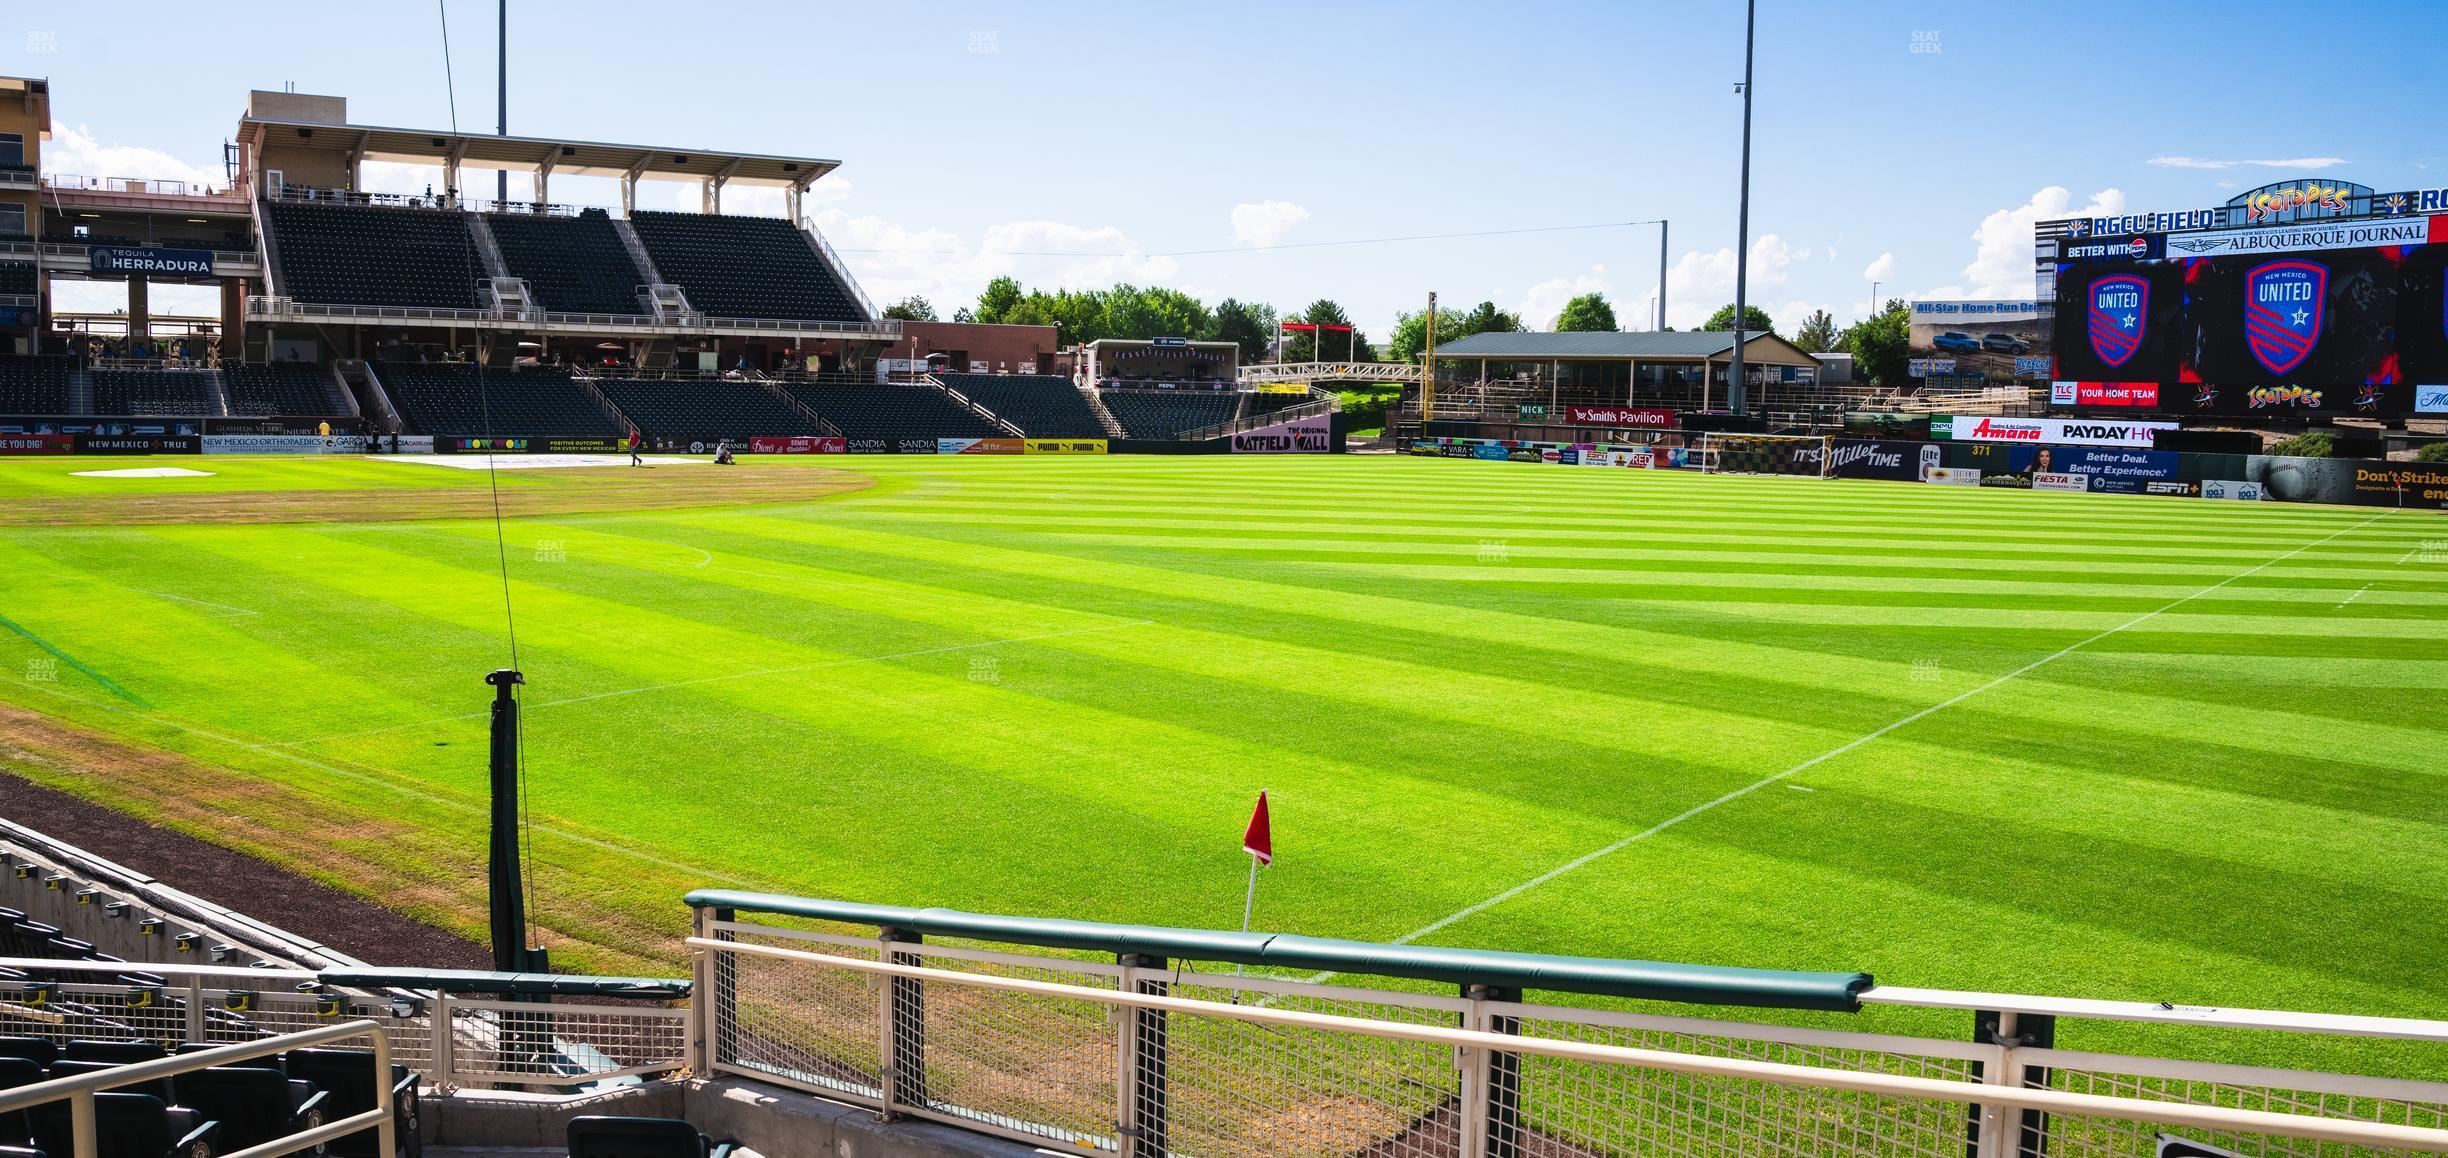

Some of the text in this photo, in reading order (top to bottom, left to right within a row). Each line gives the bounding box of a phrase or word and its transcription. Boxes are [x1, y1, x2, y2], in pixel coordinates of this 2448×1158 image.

[2245, 182, 2350, 222] ISOTOPES
[2093, 209, 2215, 236] RGCU FIELD
[2229, 225, 2426, 250] ALBUQUERQUE JOURNAL
[112, 249, 154, 257] TEQUILA
[2068, 244, 2132, 258] BETTER WITH
[112, 258, 210, 272] HERRADURA
[2259, 282, 2312, 302] UNITED
[2099, 293, 2138, 308] UNITED
[1916, 303, 1959, 313] All-Star
[1962, 303, 1994, 313] Home
[1996, 303, 2019, 313] Run
[2296, 313, 2304, 321] 18
[2055, 386, 2073, 394] TLC
[2081, 389, 2155, 398] YOUR HOME TEAM
[2247, 384, 2323, 409] ISOTOPES
[1521, 406, 1544, 414] NICK
[1587, 409, 1664, 424] Smith's Pavilion
[1972, 419, 2042, 439] Amana
[2063, 425, 2130, 439] PAYDAY
[9, 440, 25, 448] YOU
[27, 440, 43, 448] DIG!
[202, 438, 322, 446] NEW MEXICO ORTHOPAEDICS
[457, 439, 527, 448] MEOW WOLF
[752, 440, 775, 453] Dion's
[822, 440, 845, 453] Dion's
[848, 440, 887, 448] SANDIA
[898, 440, 937, 448] SANDIA
[1038, 443, 1060, 451] PUMA
[1072, 443, 1094, 451] PUMA
[1235, 435, 1328, 451] OATFIELD WALL
[1824, 444, 1880, 468] Miller
[1922, 450, 1939, 461] Lite
[1972, 446, 1991, 456] 371
[1633, 455, 1650, 464] RED
[1793, 449, 1902, 466] IT'S TIME
[2086, 453, 2148, 463] Better Deal.
[2069, 464, 2101, 474] Better
[2034, 475, 2068, 483] FIESTA
[2357, 470, 2448, 485] Don't Strike
